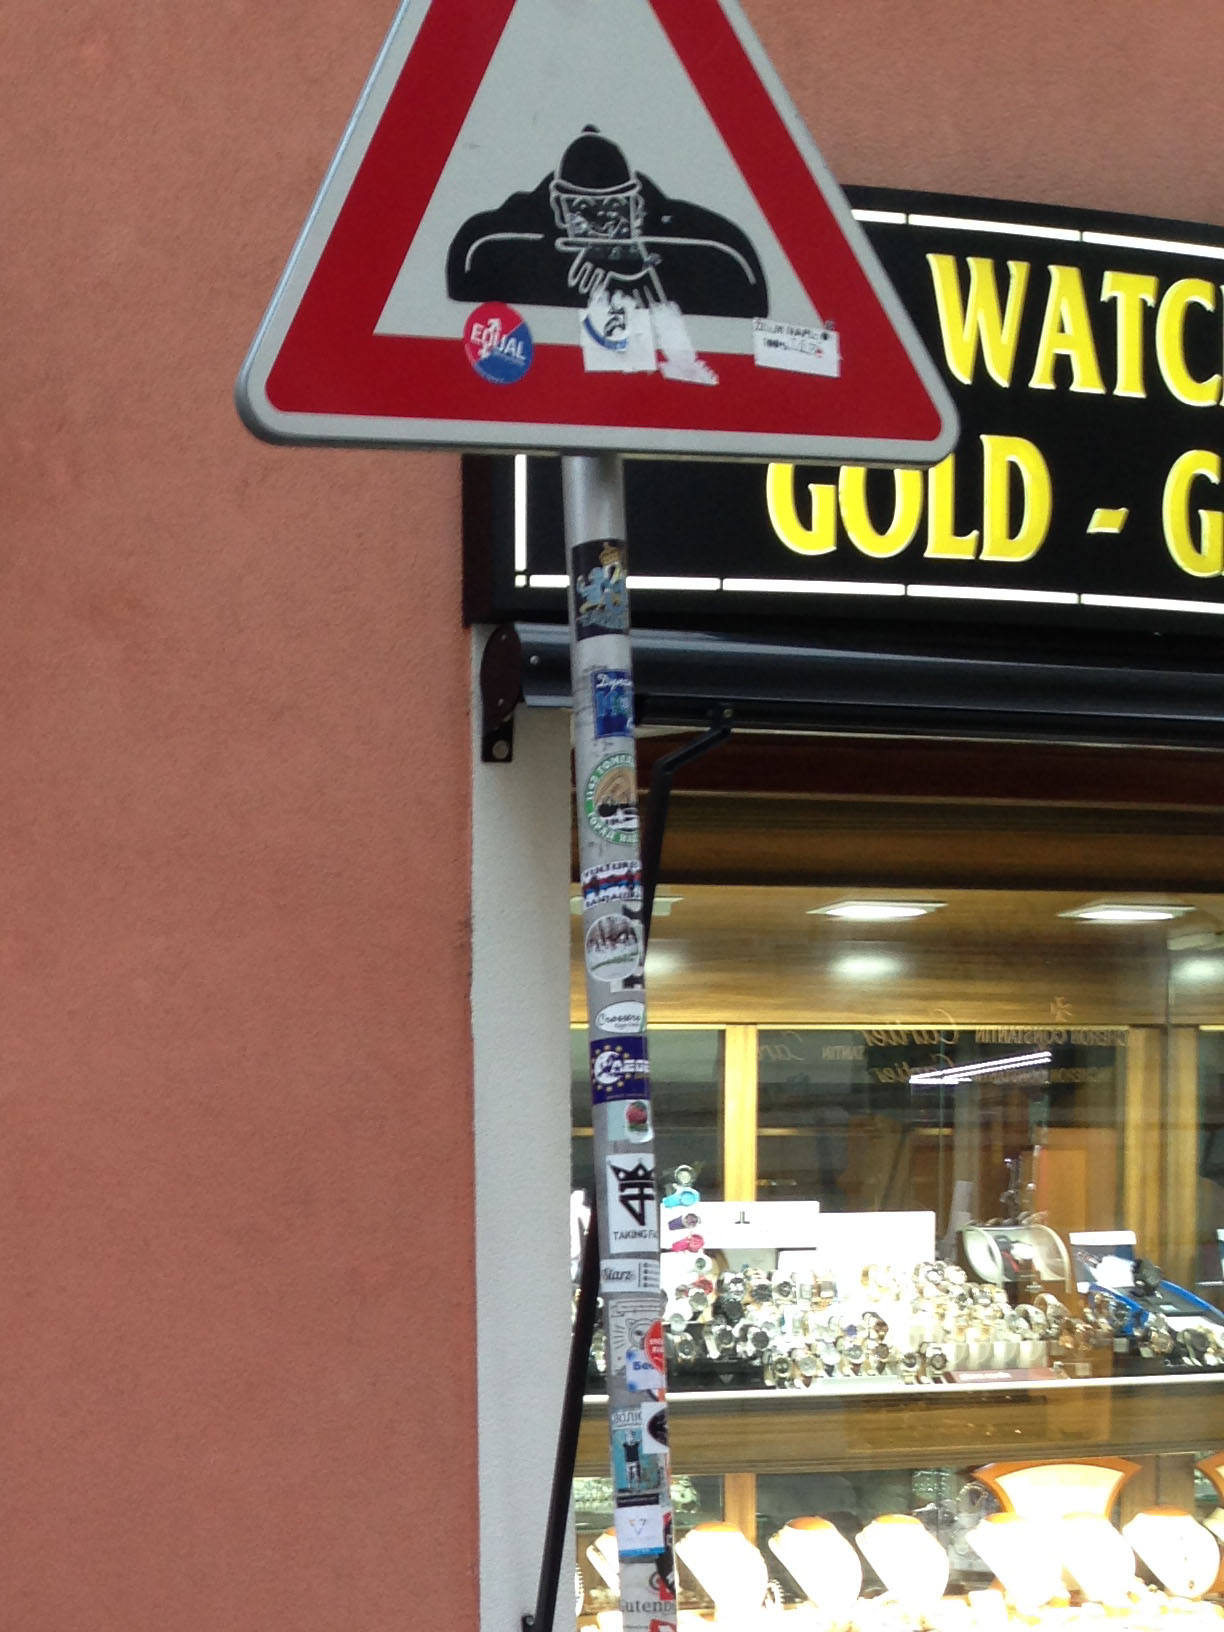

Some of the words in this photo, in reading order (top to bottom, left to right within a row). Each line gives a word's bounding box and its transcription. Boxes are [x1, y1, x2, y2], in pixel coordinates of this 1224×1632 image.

[470, 319, 526, 361] EQUAL
[926, 252, 1224, 408] WATC
[765, 434, 1052, 563] GOLD
